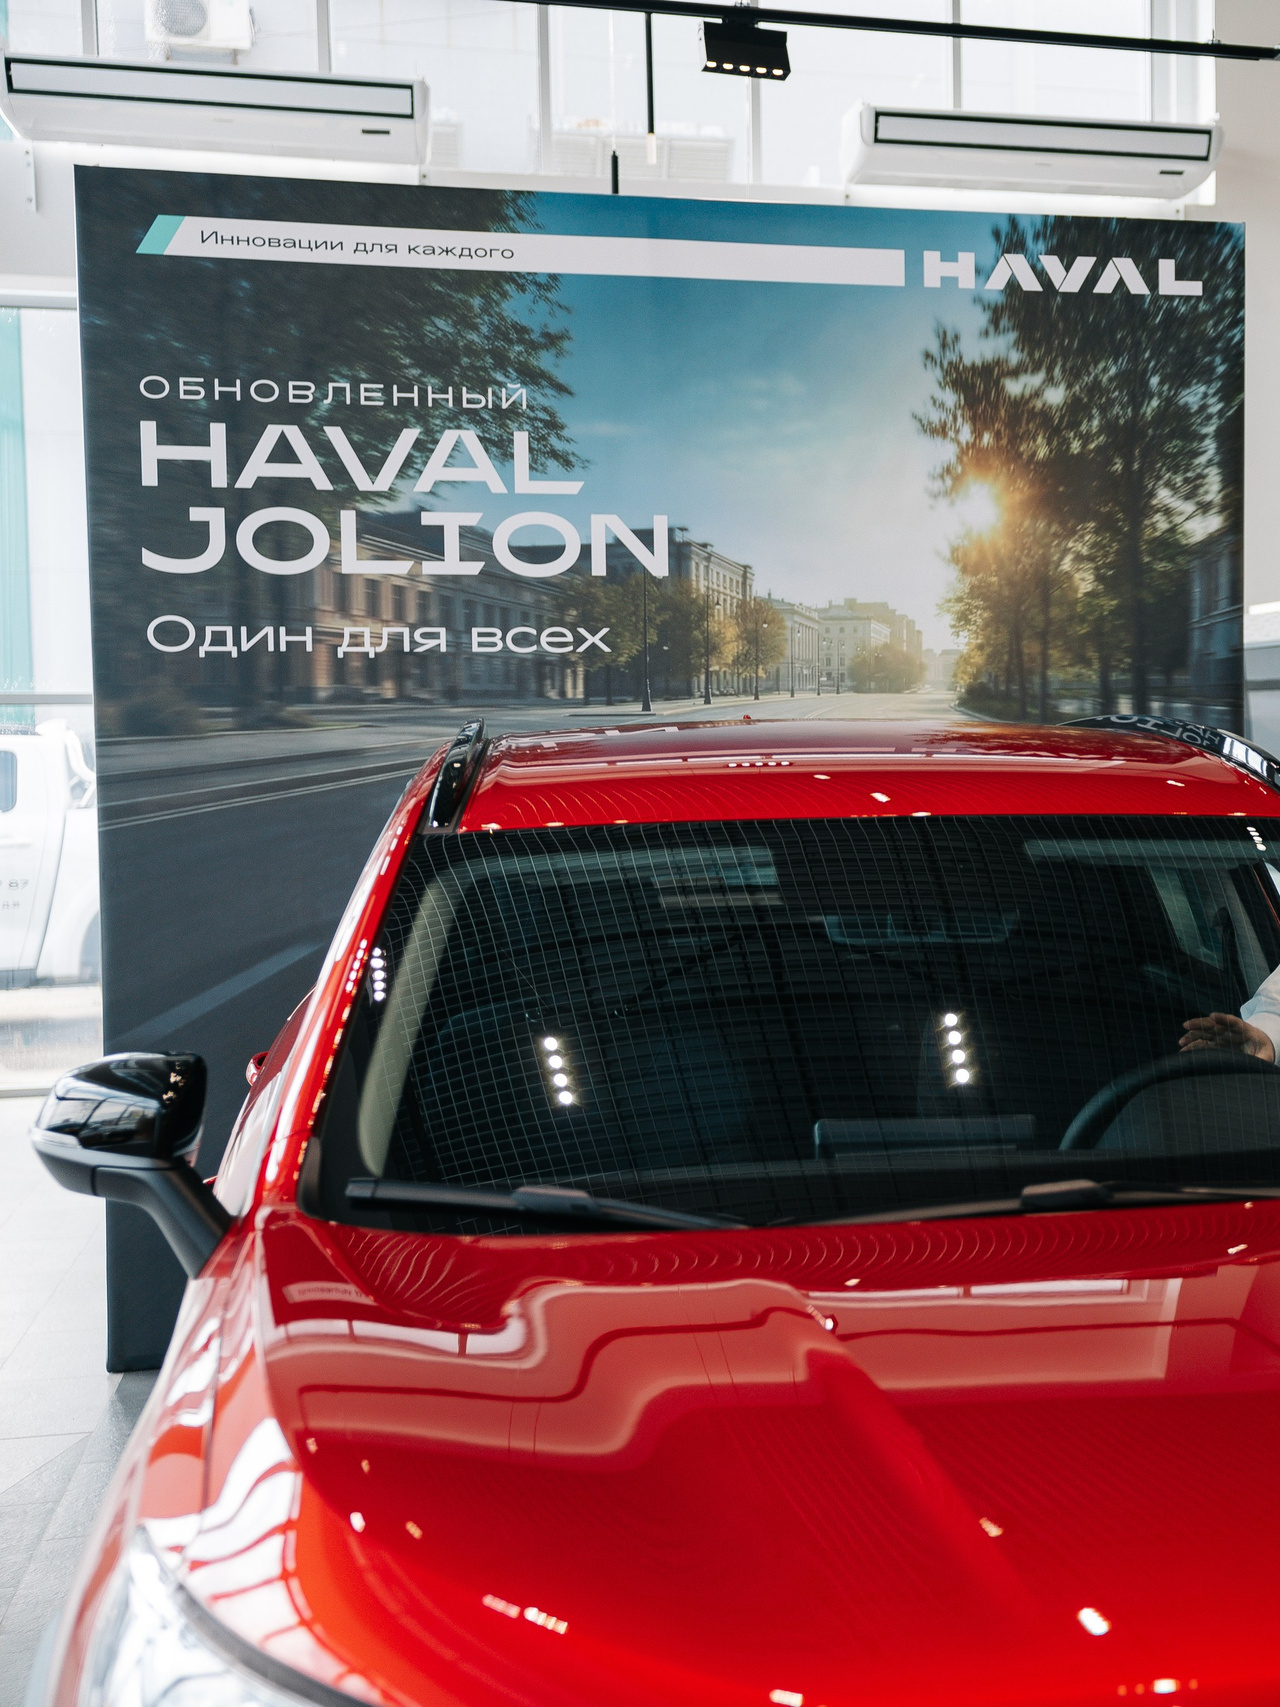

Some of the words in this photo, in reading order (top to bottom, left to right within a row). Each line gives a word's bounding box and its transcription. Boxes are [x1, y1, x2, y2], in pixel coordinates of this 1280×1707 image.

[200, 229, 344, 252] Инновации
[353, 241, 398, 254] для
[408, 244, 515, 260] каждого
[923, 250, 1203, 296] HAVAL
[139, 375, 528, 410] ОБНОВЛЕННЫЙ
[140, 420, 585, 495] HAVAL
[141, 506, 669, 578] JOLION
[147, 614, 313, 658] Один
[337, 625, 447, 659] для
[471, 626, 612, 653] всех
